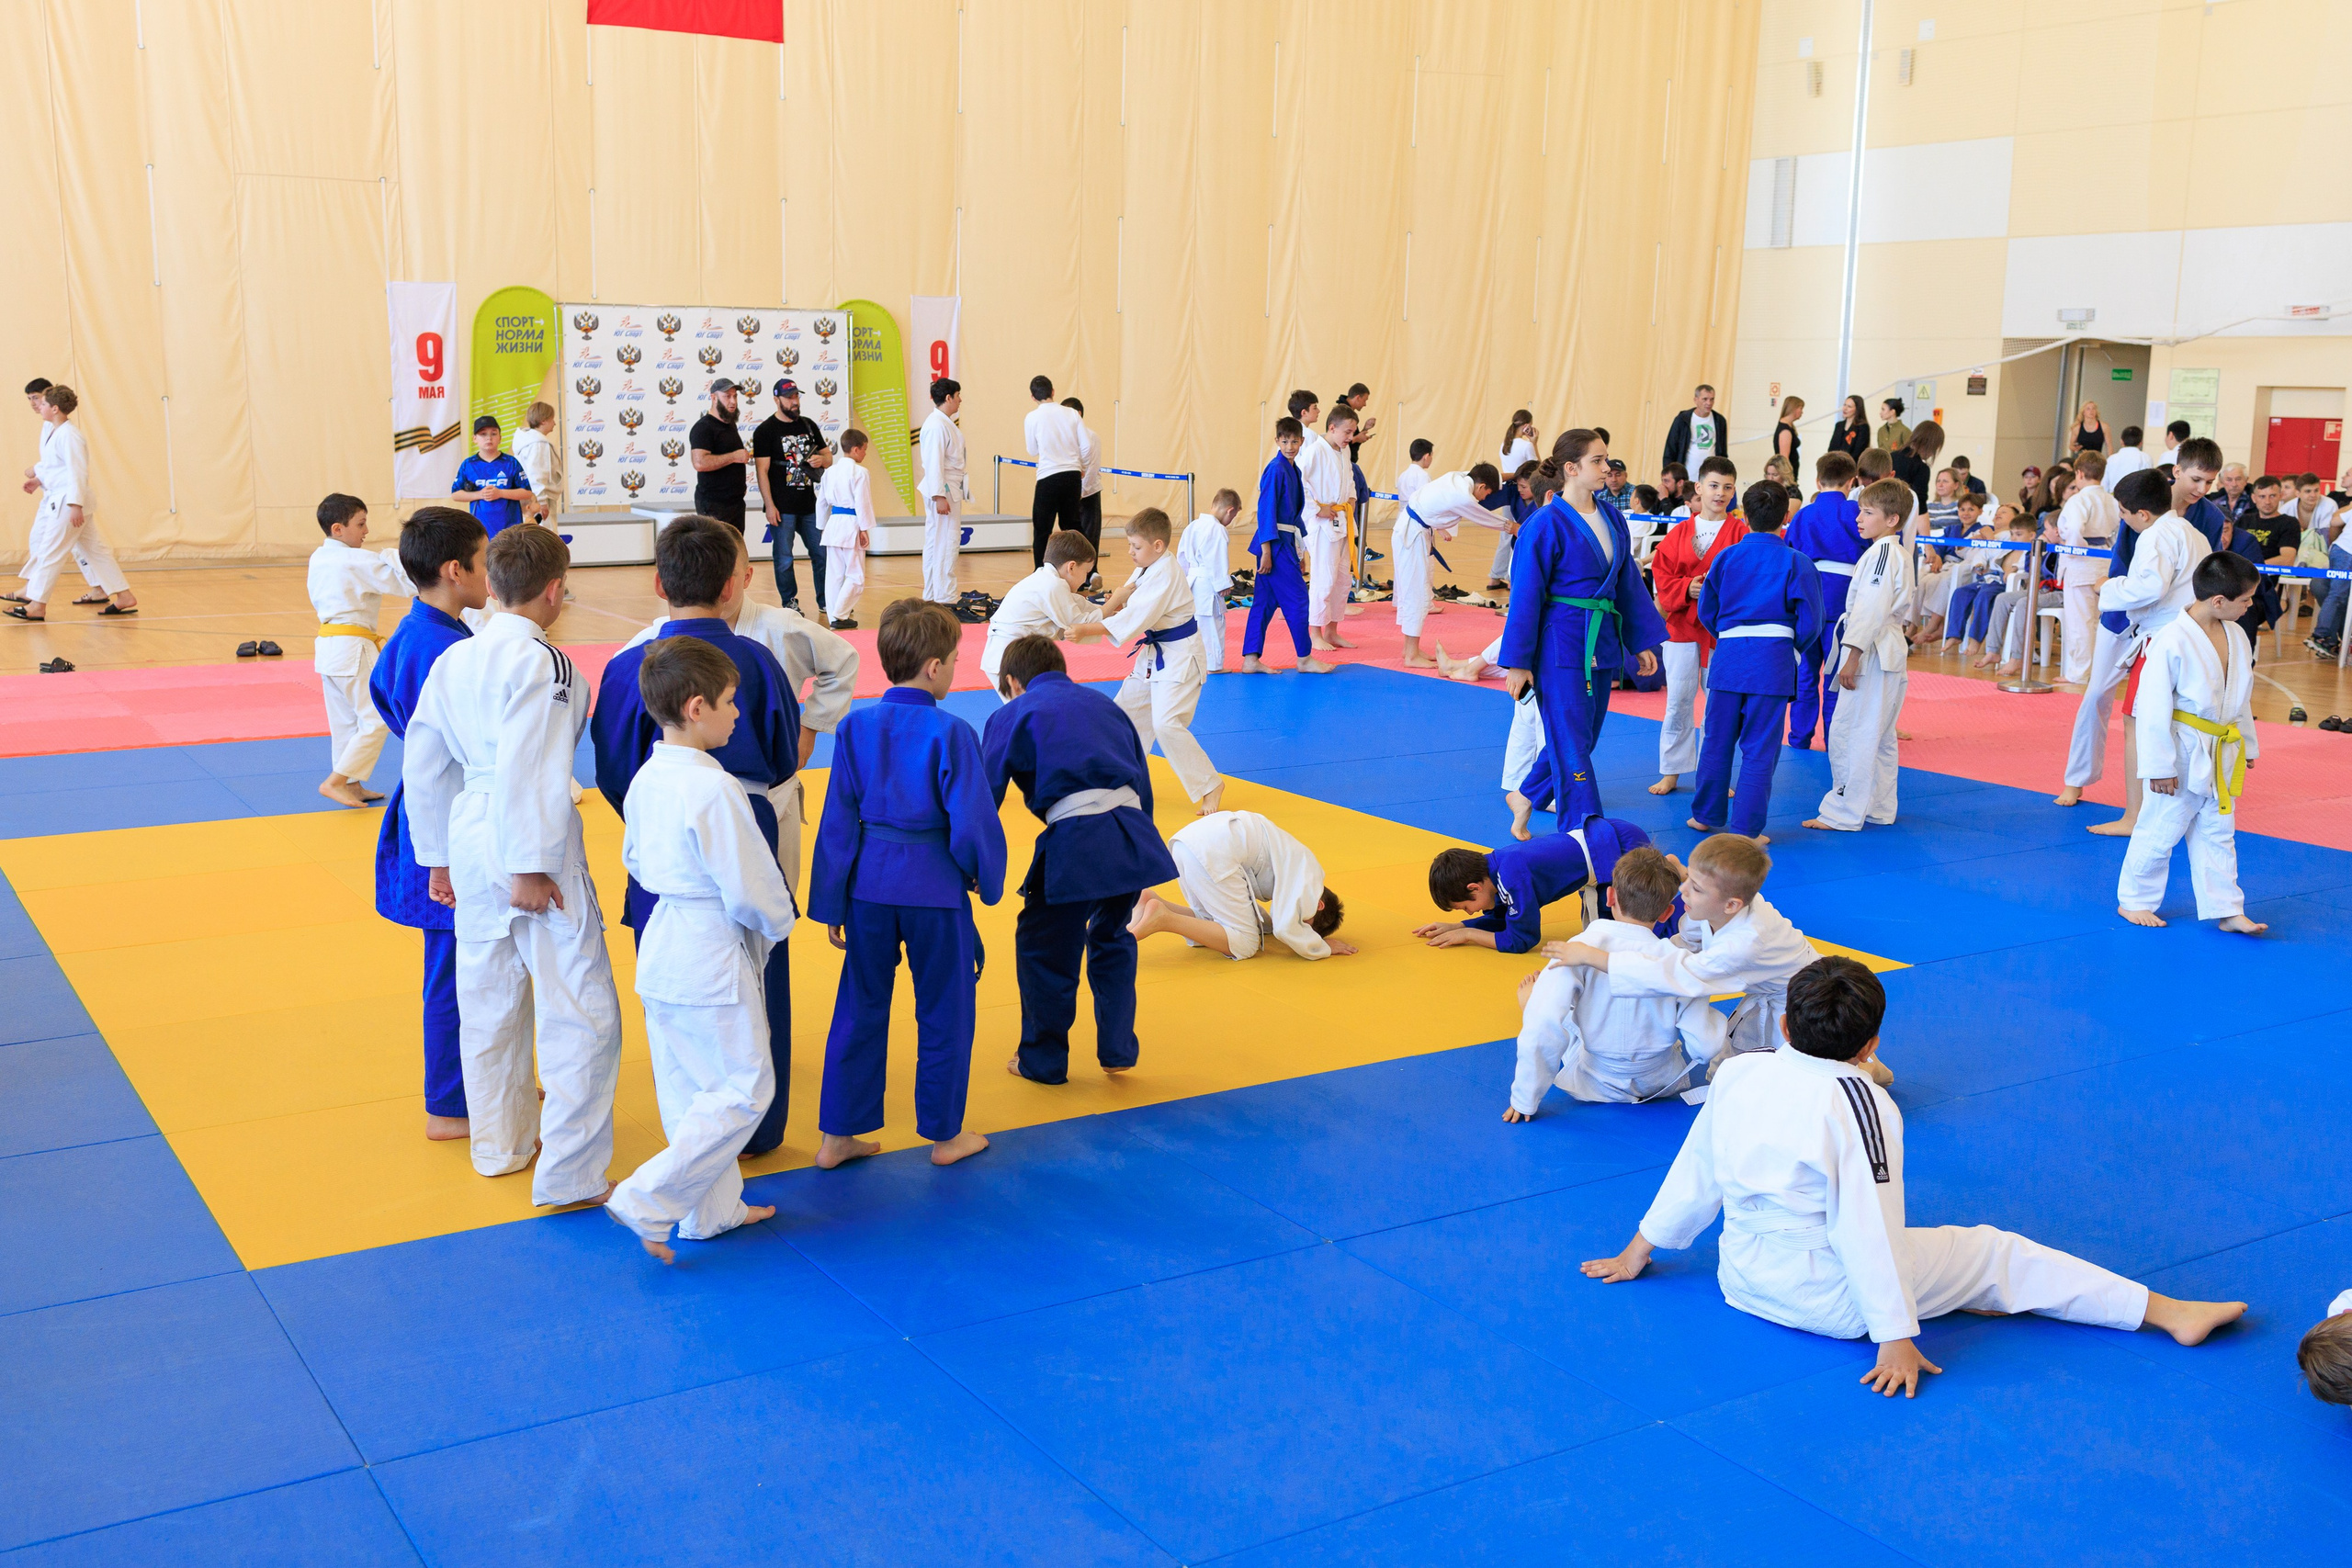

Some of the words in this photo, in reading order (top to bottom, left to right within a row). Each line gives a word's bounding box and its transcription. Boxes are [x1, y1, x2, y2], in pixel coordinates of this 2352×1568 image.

[495, 316, 535, 327] СПОРТ
[495, 329, 544, 341] НОРМА
[848, 326, 873, 338] ОРТ
[495, 342, 543, 354] ЖИЗНИ
[848, 339, 882, 350] ОРМА
[416, 332, 443, 382] 9
[848, 350, 882, 362] ИЗНИ
[930, 340, 949, 383] 9
[418, 386, 445, 399] МАЯ
[2055, 545, 2071, 554] СОЧИ
[2072, 547, 2089, 556] 2014
[2326, 570, 2347, 579] СОЧИ
[553, 695, 568, 704] adidas
